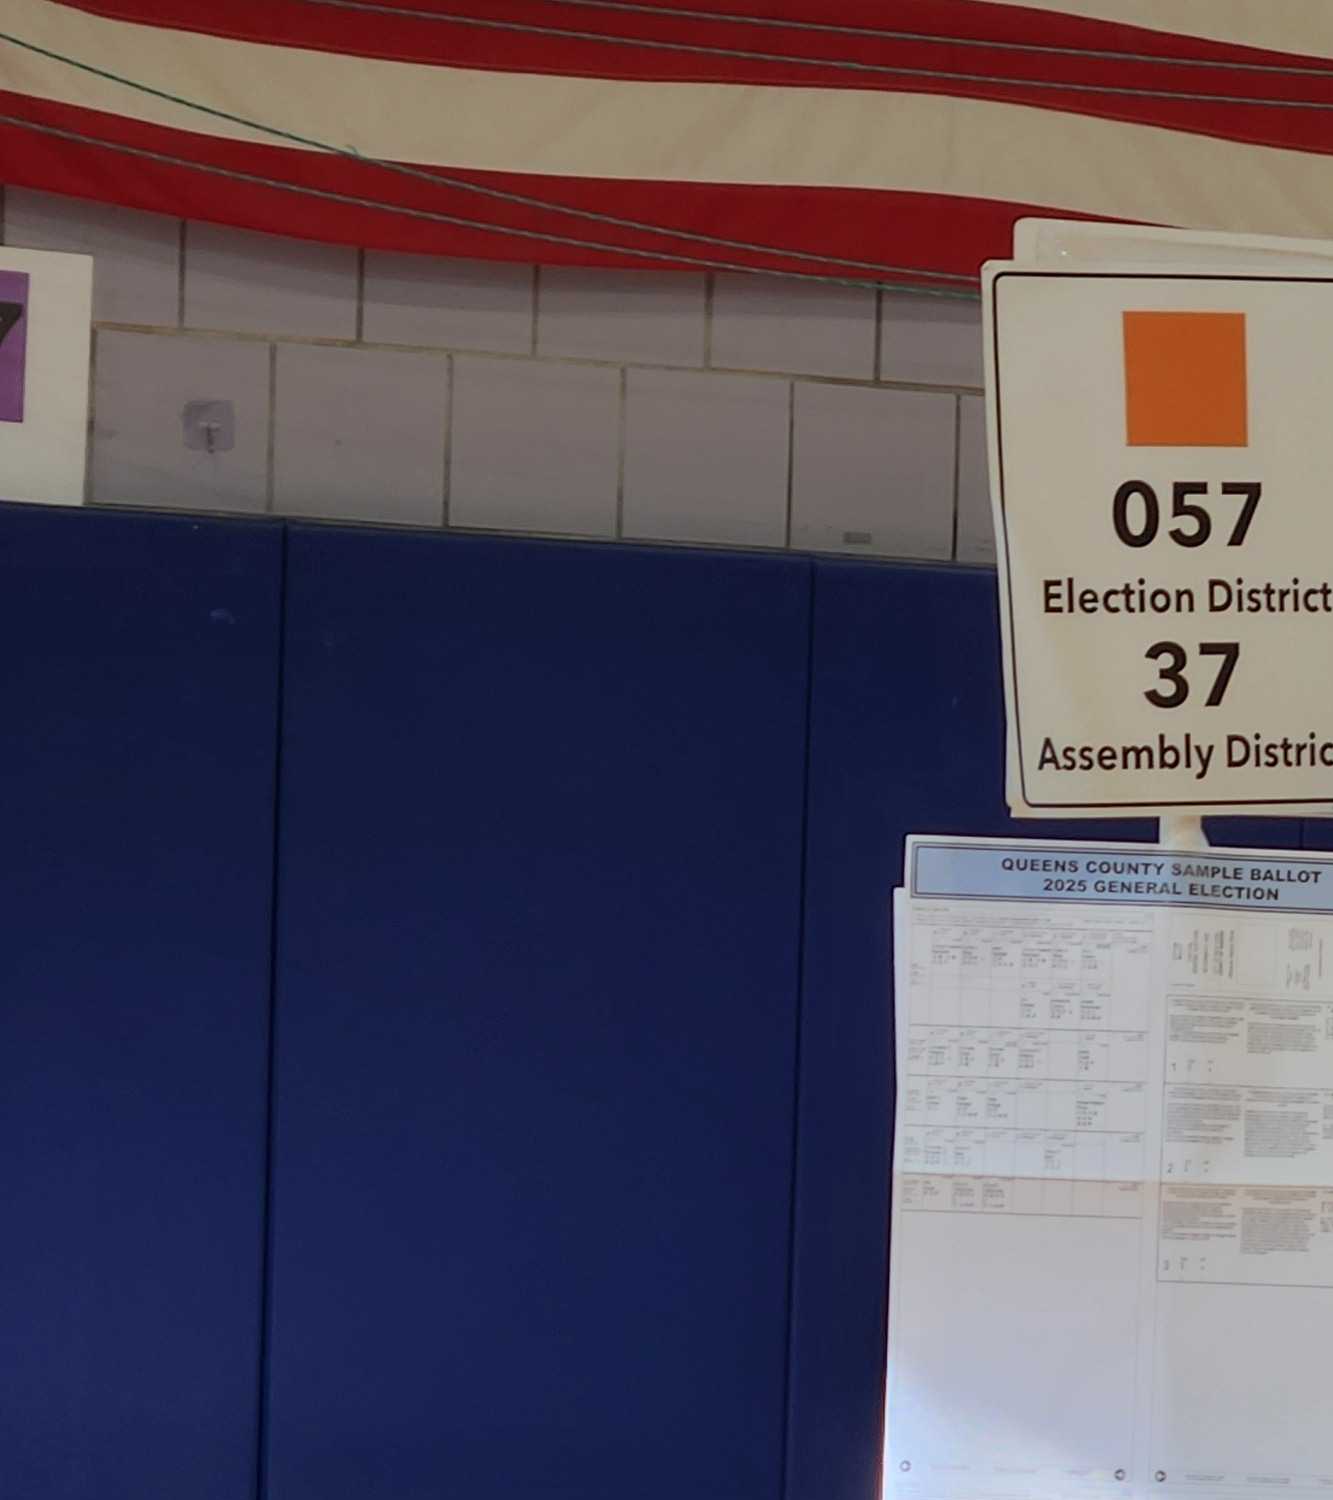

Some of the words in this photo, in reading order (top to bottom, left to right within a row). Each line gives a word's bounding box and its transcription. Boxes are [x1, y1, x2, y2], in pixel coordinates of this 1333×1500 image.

[1112, 480, 1263, 548] 057
[1043, 577, 1195, 613] Election
[1208, 578, 1333, 613] District
[1143, 641, 1241, 709] 37
[1038, 733, 1215, 780] Assembly
[1001, 857, 1079, 874] QUEENS
[1086, 860, 1166, 877] COUNTY
[1171, 863, 1244, 881] SAMPLE
[1250, 867, 1322, 885] BALLOT
[1043, 878, 1088, 894] 2025
[1094, 879, 1183, 897] GENERAL
[1188, 882, 1279, 901] ELECTION
